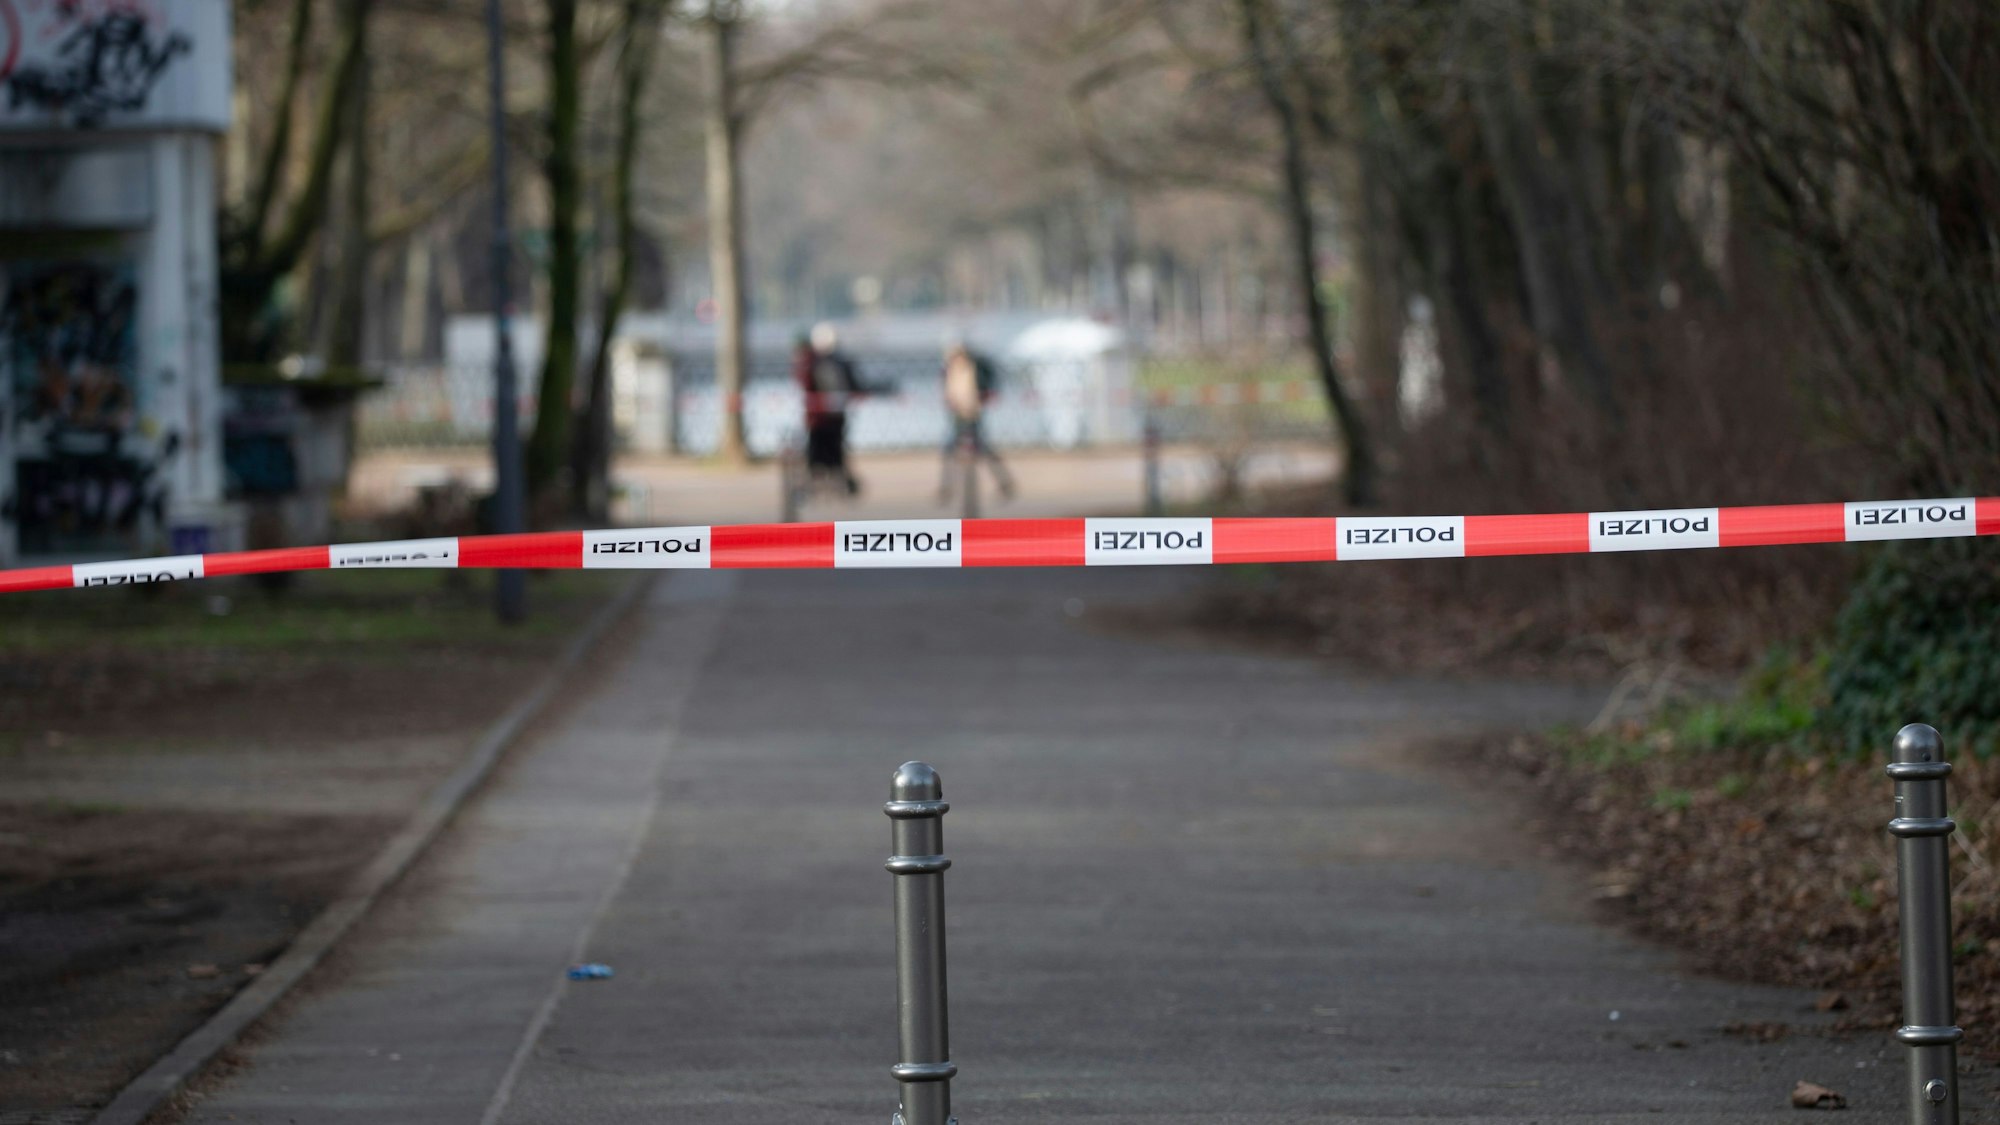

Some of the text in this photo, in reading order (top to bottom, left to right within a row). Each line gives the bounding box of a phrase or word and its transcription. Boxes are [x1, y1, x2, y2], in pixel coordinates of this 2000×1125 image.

[1855, 505, 1966, 526] POLIZEI
[1346, 526, 1454, 544] POLIZEI
[1599, 517, 1709, 536] POLIZEI
[593, 538, 701, 553] POLIZEI
[844, 532, 952, 552] POLIZEI
[1095, 531, 1202, 550] POLIZEI
